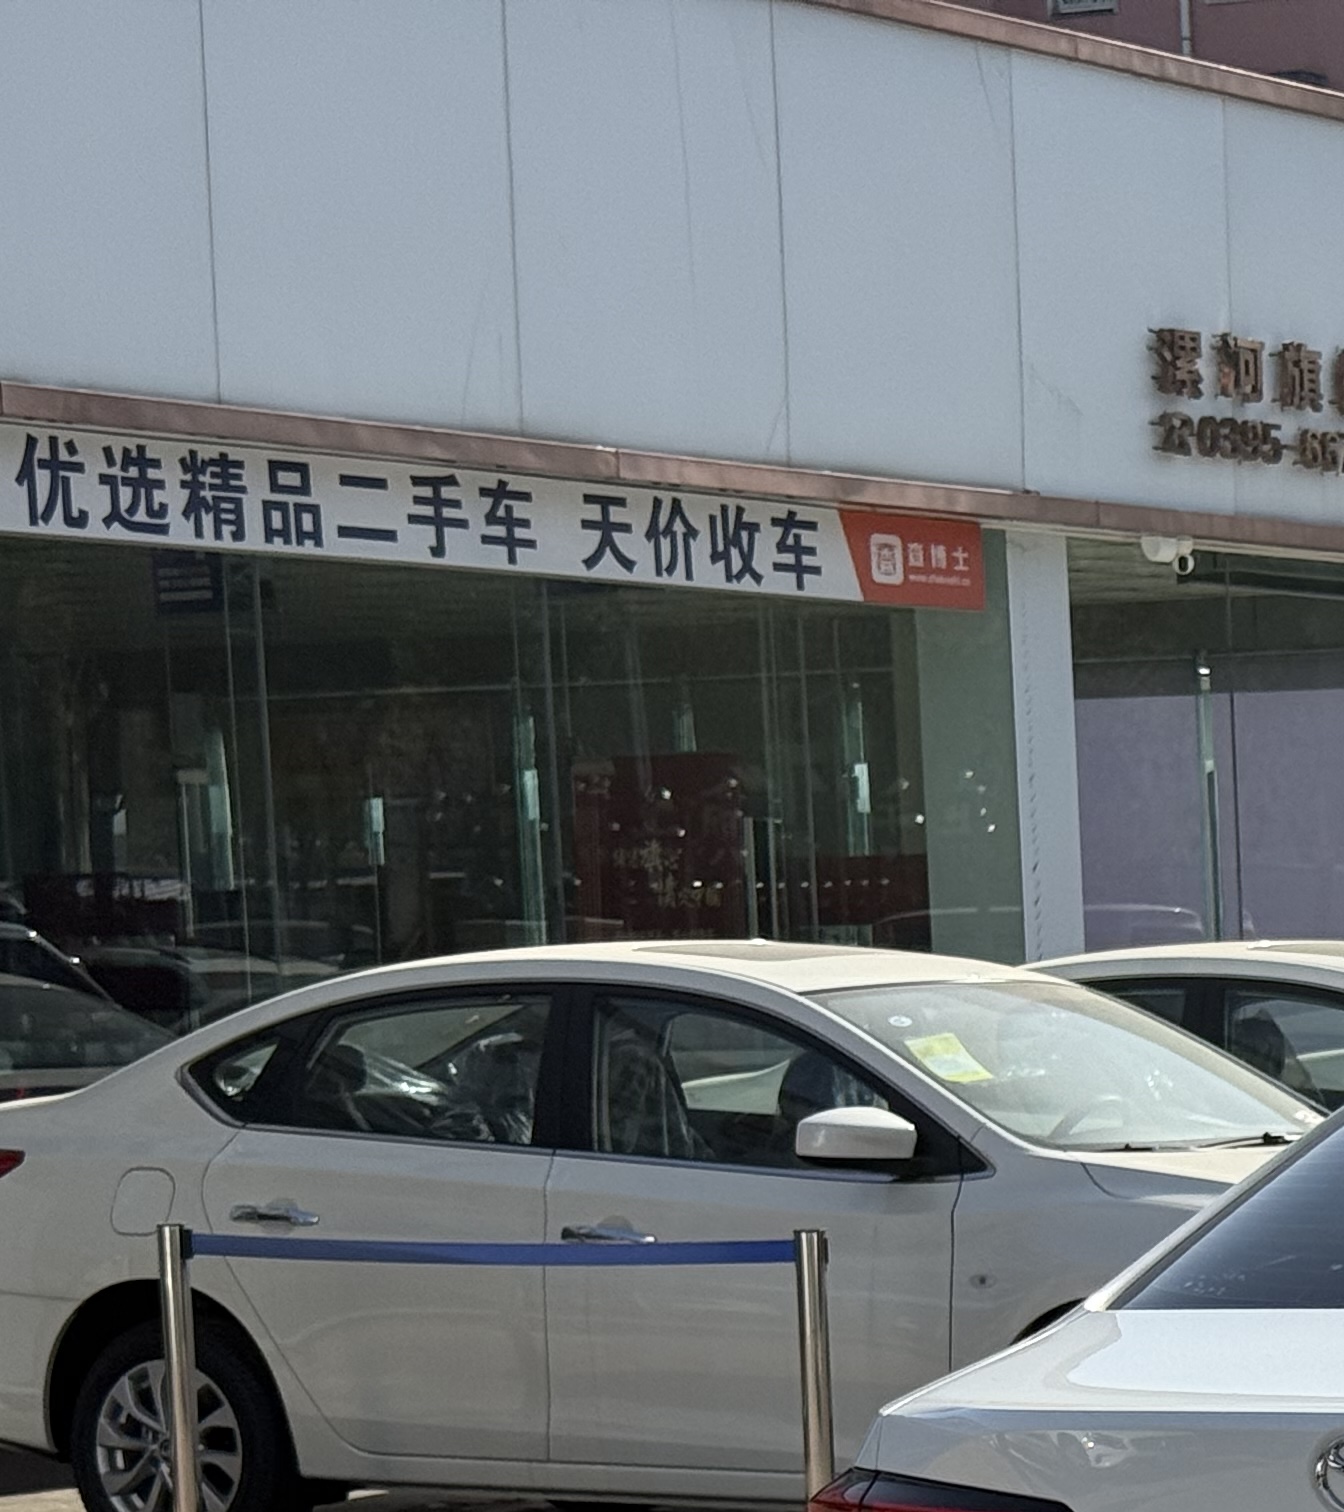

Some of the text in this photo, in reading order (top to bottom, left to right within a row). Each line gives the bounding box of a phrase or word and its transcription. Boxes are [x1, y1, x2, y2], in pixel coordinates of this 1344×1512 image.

[15, 432, 824, 591] 优选精品二手车 天价收车
